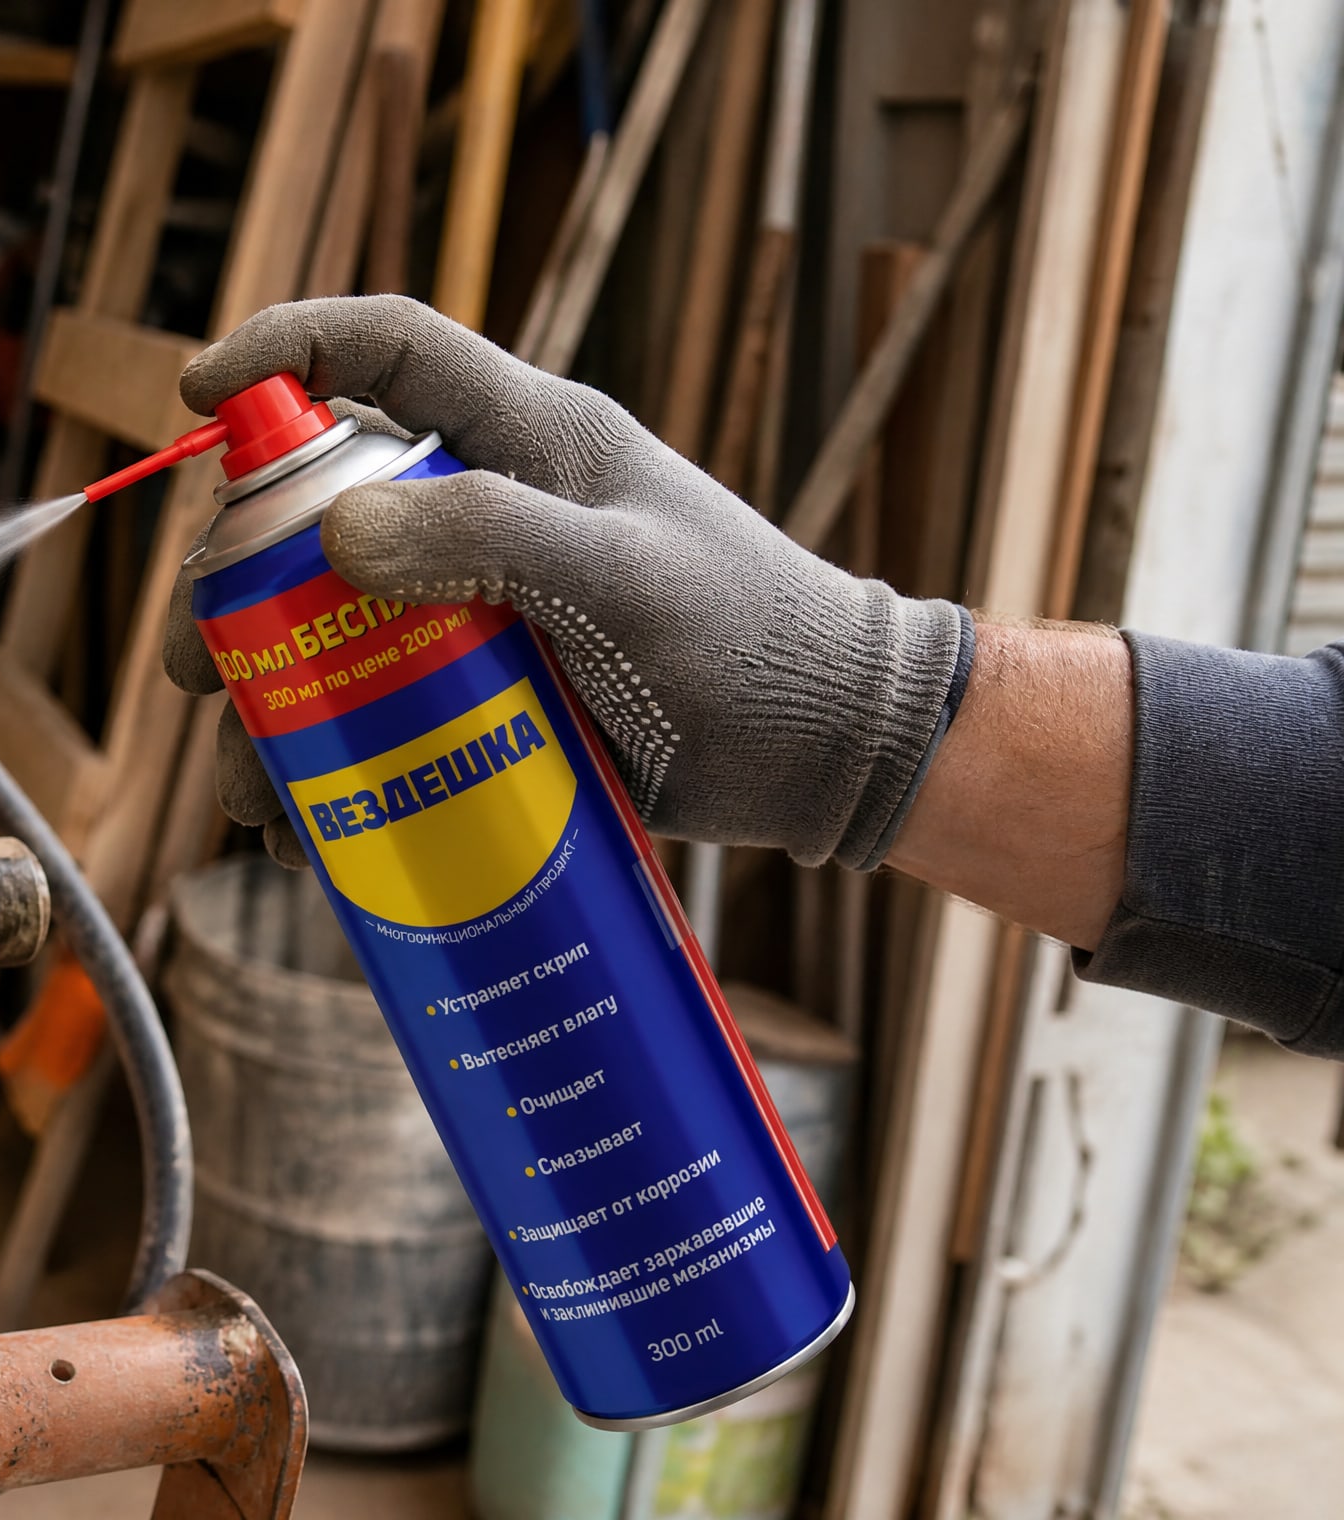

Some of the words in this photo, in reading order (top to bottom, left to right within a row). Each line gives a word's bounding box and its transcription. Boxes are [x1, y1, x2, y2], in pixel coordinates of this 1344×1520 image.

[215, 650, 253, 681] 100
[251, 642, 295, 676] мл
[263, 687, 296, 711] 300
[297, 681, 324, 702] мл
[325, 670, 350, 690] по
[351, 646, 401, 680] цене
[400, 620, 444, 655] 200
[444, 607, 472, 632] мл
[308, 710, 547, 842] ВЕЗДЕШКА
[437, 970, 530, 1016] Устраняет
[533, 942, 590, 980] скрип
[460, 1024, 560, 1071] Вытесняет
[563, 995, 618, 1033] влагу
[519, 1069, 606, 1115] Очищает
[537, 1121, 643, 1176] Смазывает
[517, 1206, 608, 1243] Защищает
[612, 1196, 633, 1216] от
[636, 1150, 721, 1206] коррозии
[529, 1261, 640, 1300] Освобождает
[644, 1196, 766, 1273] заржавевшие
[540, 1308, 550, 1321] и
[551, 1277, 671, 1322] заклинившие
[673, 1219, 776, 1287] механизмы
[647, 1333, 692, 1362] 300
[695, 1318, 724, 1346] ml
